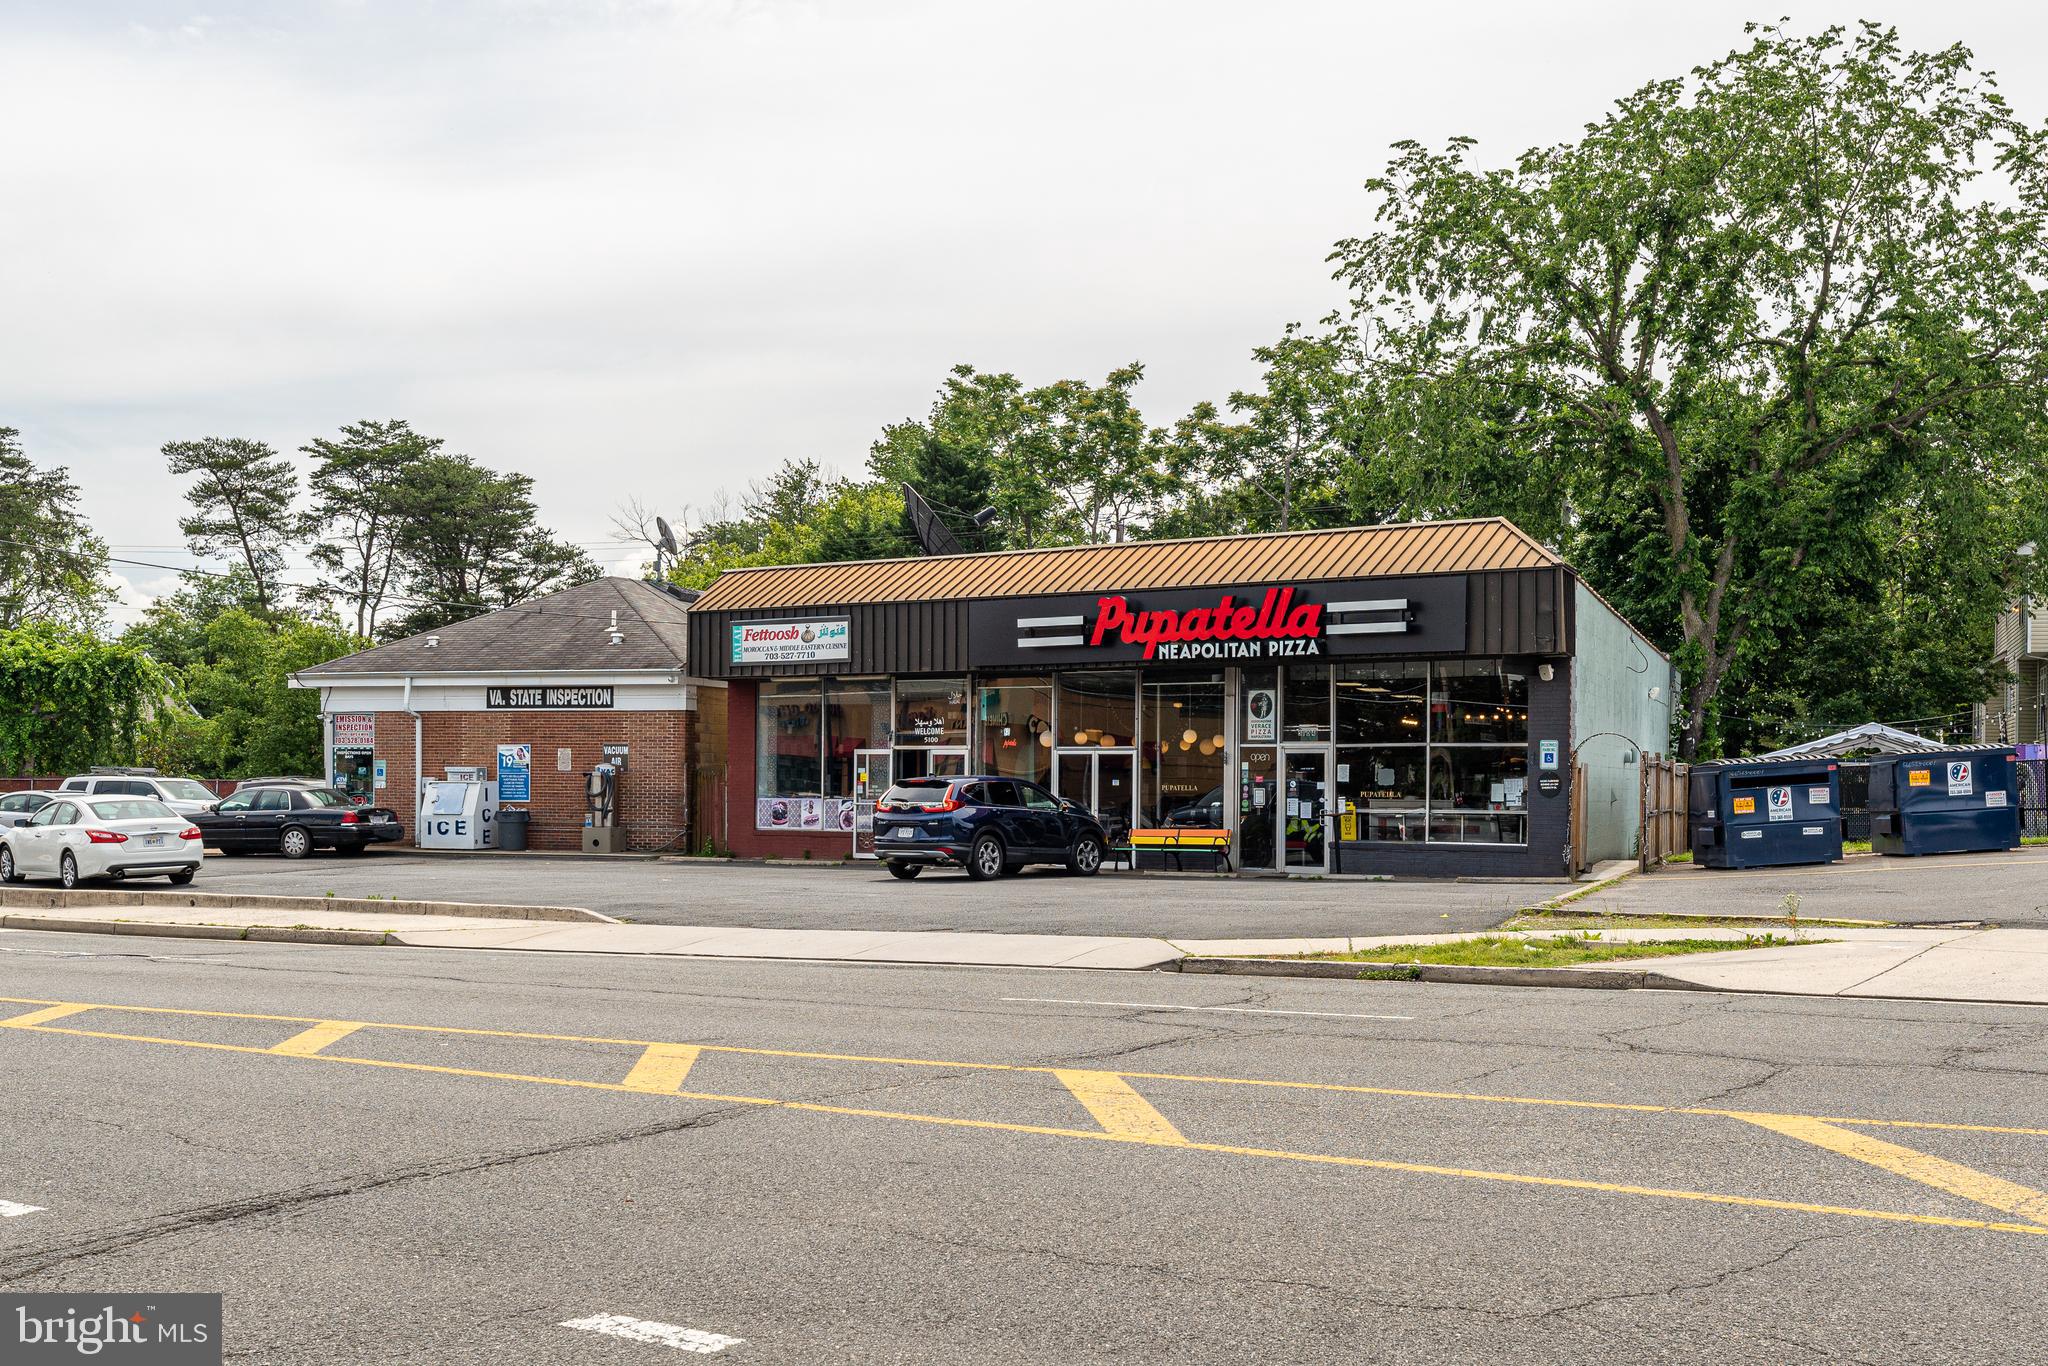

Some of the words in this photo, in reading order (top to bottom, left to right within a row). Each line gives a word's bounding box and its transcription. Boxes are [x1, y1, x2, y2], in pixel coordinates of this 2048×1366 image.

[1090, 587, 1324, 660] Pupatella
[744, 625, 799, 642] Fettoosh
[779, 644, 800, 652] MIDDLE
[800, 643, 825, 651] EASTERN
[825, 642, 847, 650] CUISINE
[1158, 641, 1260, 660] NEAPOLITAN
[1269, 639, 1320, 657] PIZZA
[764, 651, 816, 660] 703-527-7710
[489, 689, 506, 705] VA.
[510, 689, 542, 706] STATE
[546, 688, 611, 705] INSPECTION
[336, 715, 366, 723] EMISSION
[914, 727, 944, 735] WELCOME
[603, 746, 629, 755] VACUUM
[611, 757, 622, 765] AIR
[1250, 753, 1270, 763] open
[427, 820, 467, 836] ICE
